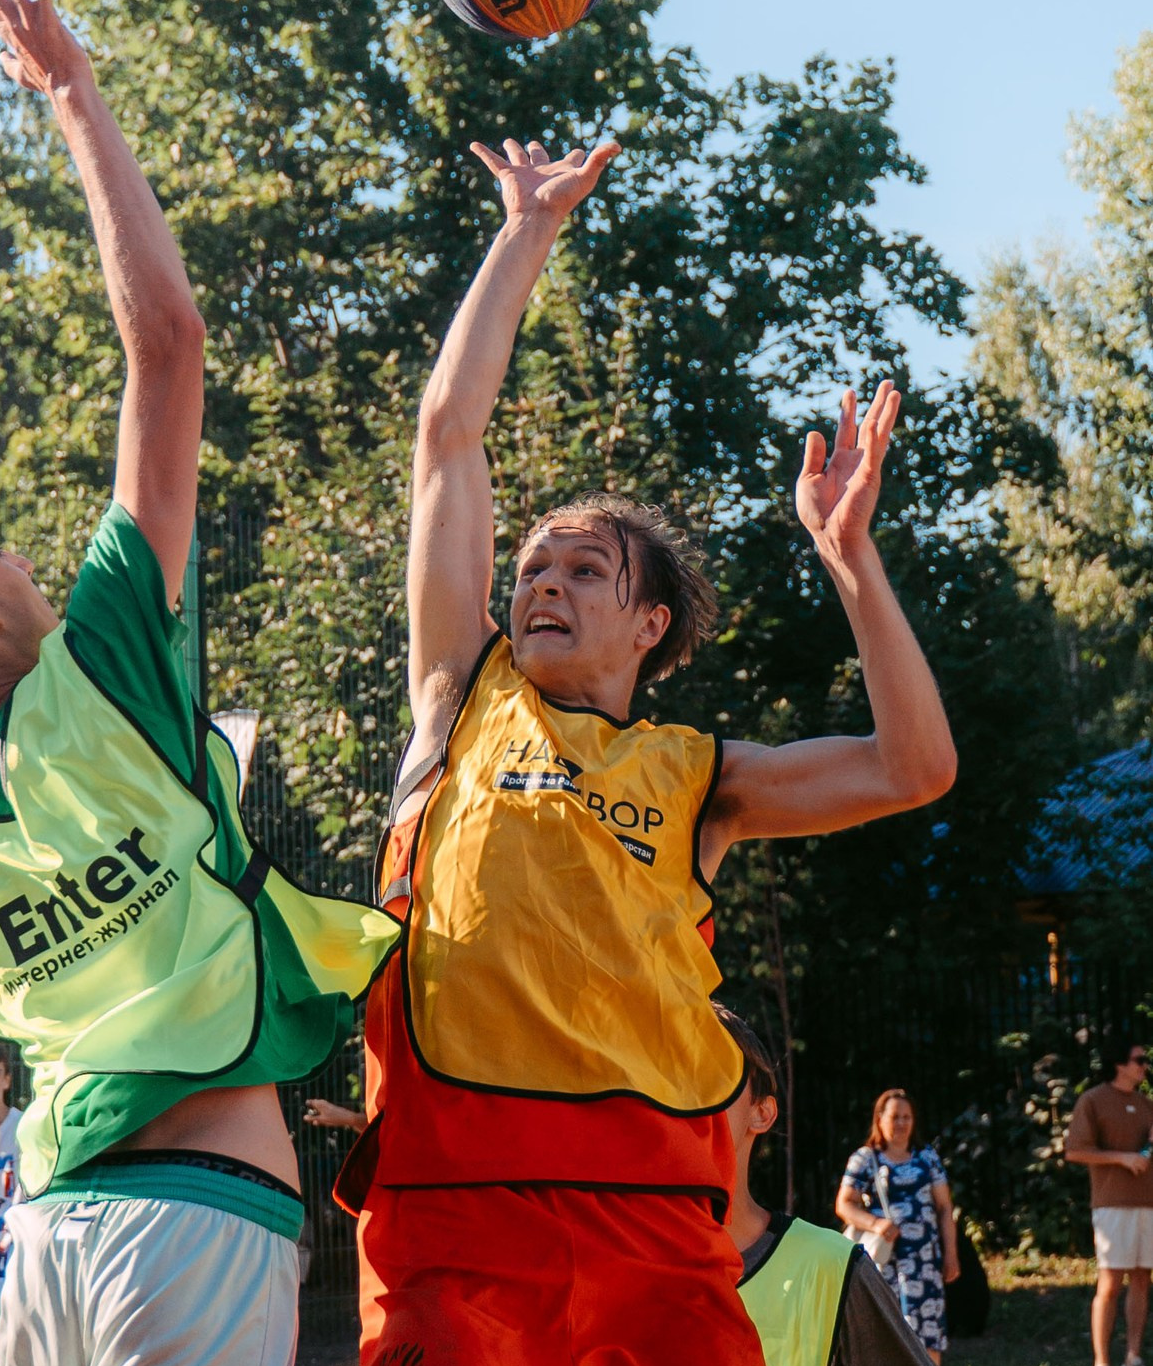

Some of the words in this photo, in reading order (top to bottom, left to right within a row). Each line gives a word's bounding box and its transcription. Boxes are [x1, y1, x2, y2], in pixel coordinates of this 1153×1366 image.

[501, 738, 550, 763] НА
[586, 791, 664, 834] ВОР
[4, 868, 180, 996] интернет-журнал
